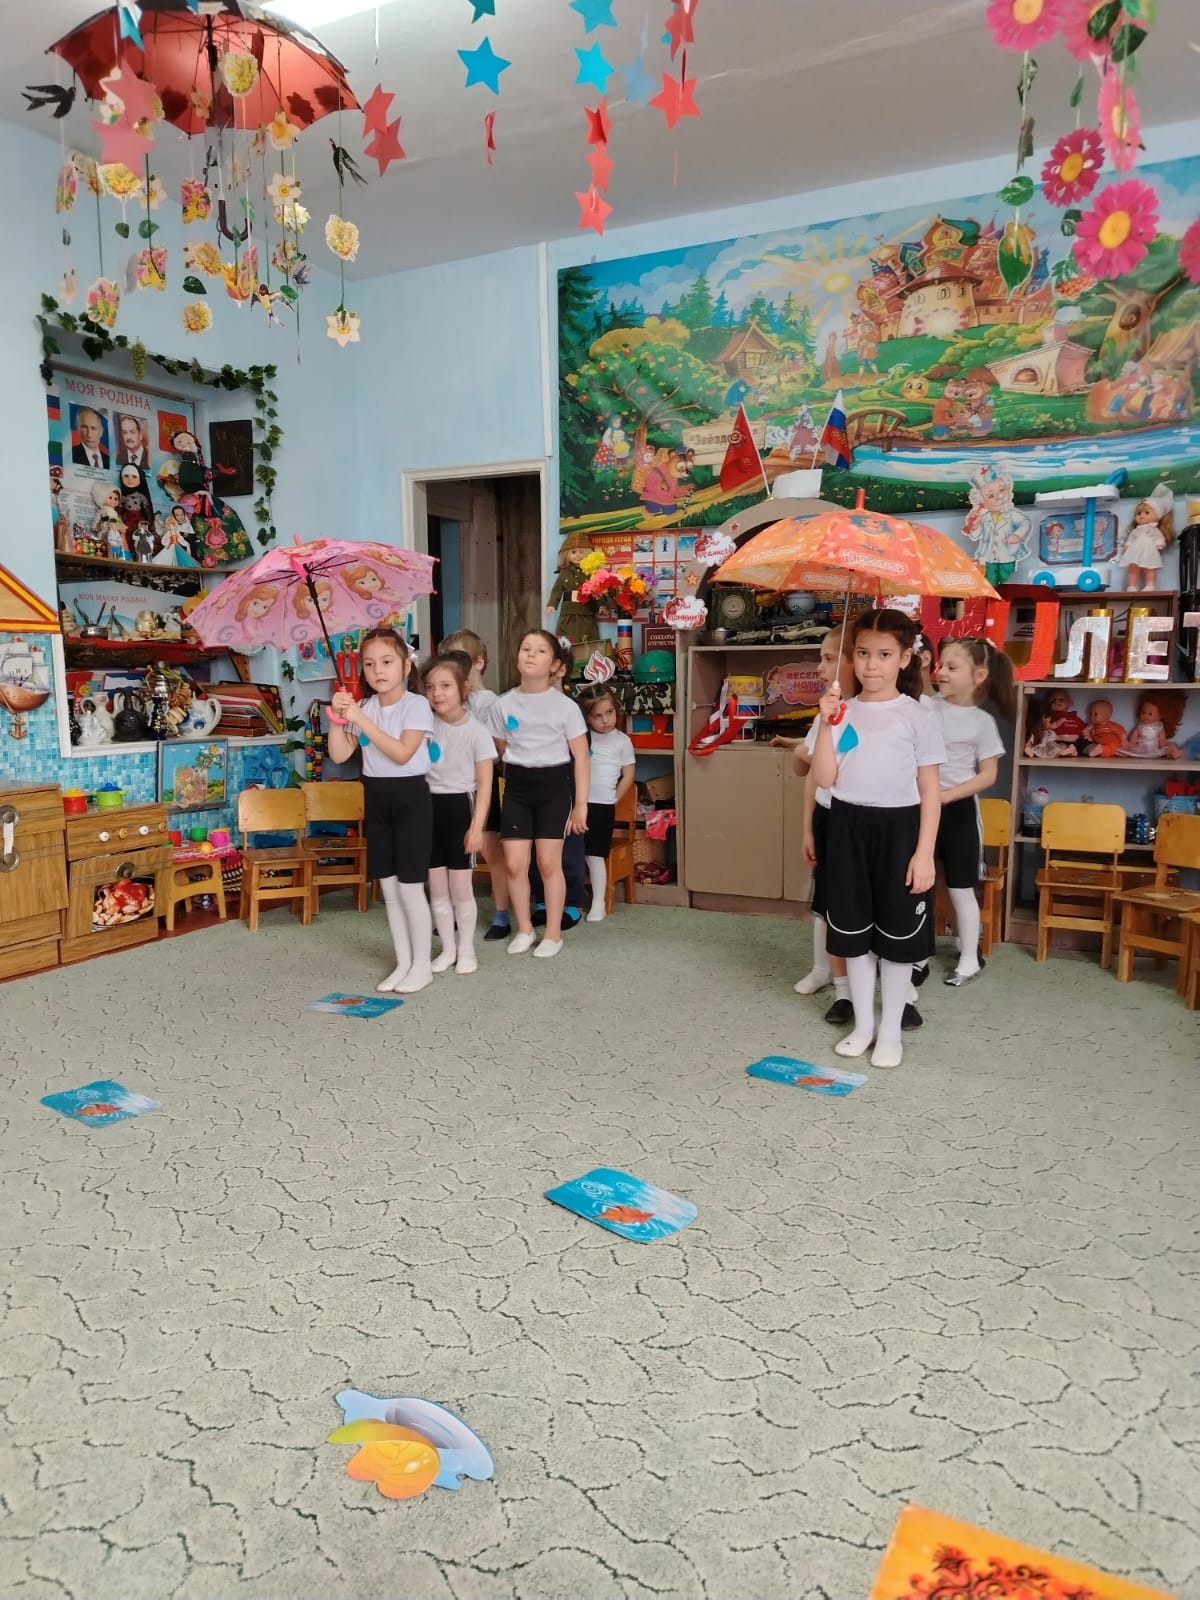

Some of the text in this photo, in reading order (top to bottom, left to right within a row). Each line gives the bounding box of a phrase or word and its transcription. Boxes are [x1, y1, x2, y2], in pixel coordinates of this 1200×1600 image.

[65, 378, 152, 411] МОЯ РОДИНА
[787, 671, 821, 680] ВЕСЕЛ
